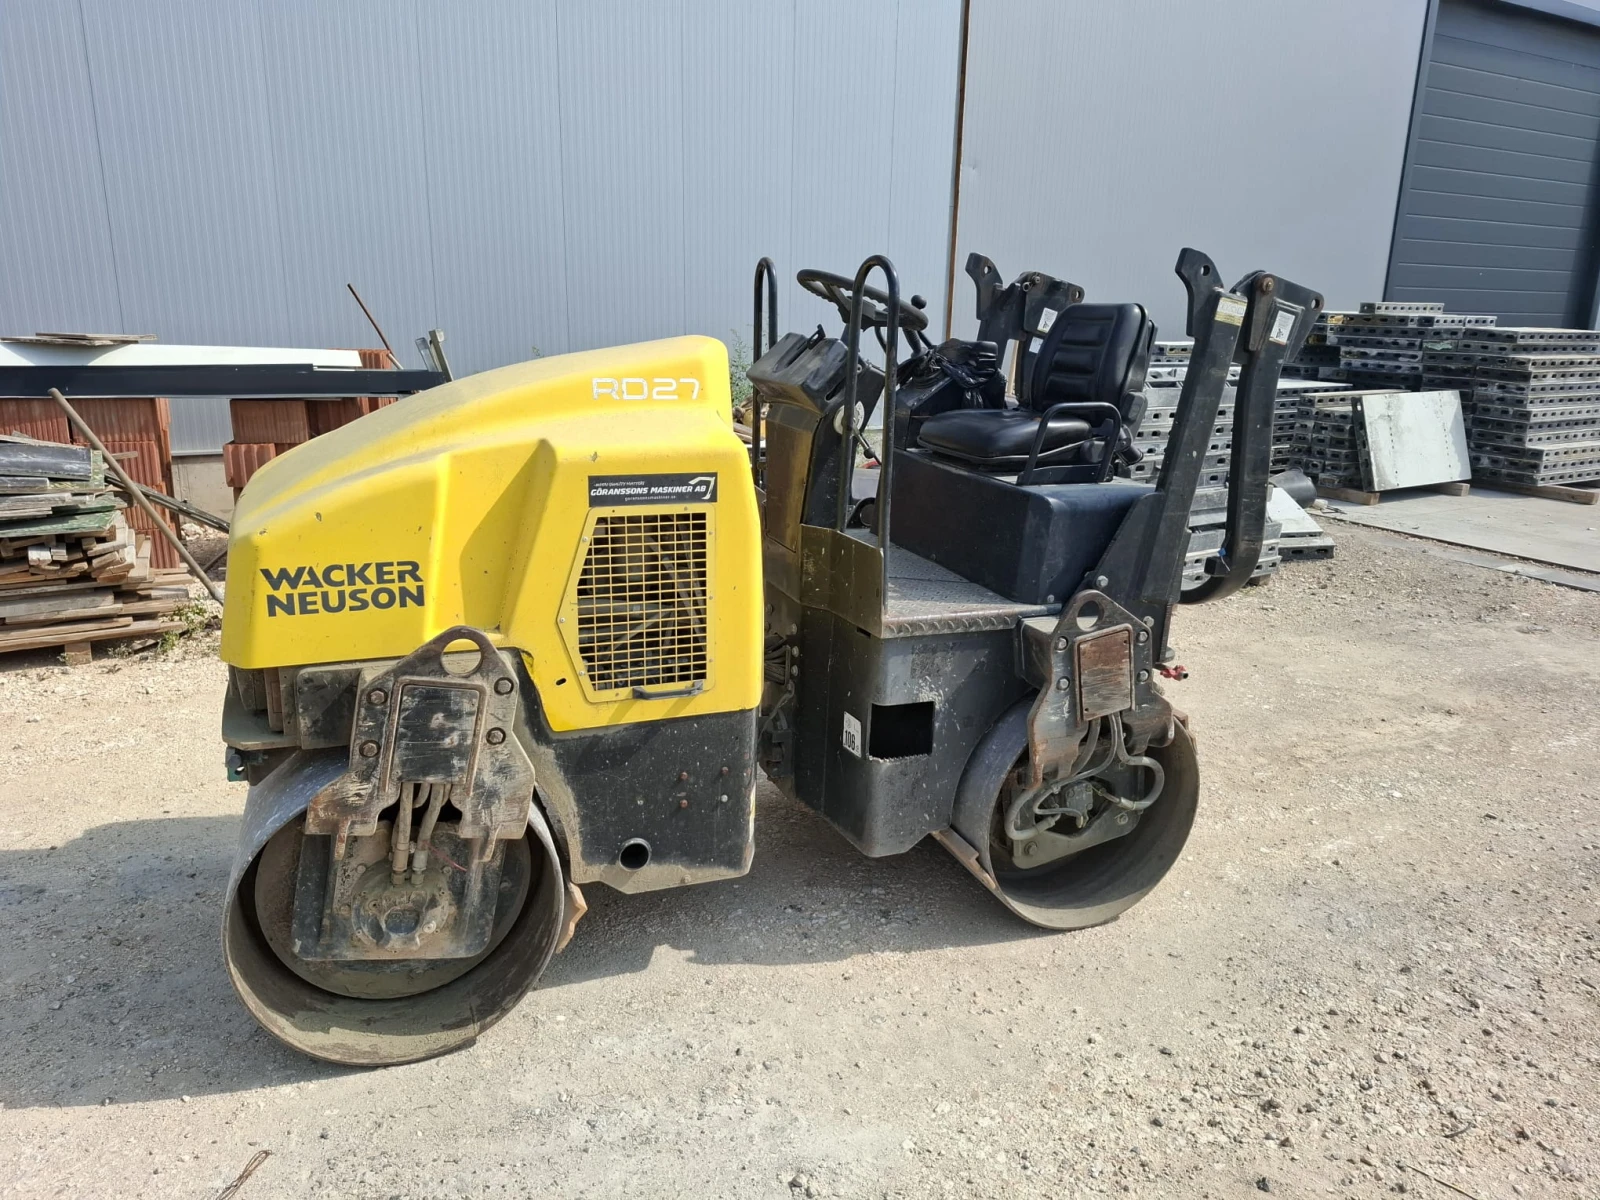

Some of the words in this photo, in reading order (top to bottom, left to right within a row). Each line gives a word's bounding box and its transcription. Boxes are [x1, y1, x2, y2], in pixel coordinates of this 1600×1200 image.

[592, 377, 700, 400] RD27
[590, 486, 649, 496] GÖRANSSONS
[649, 485, 693, 494] MASKINER
[259, 560, 424, 591] WACKER
[266, 585, 425, 617] NEUSON
[845, 730, 856, 751] 106
